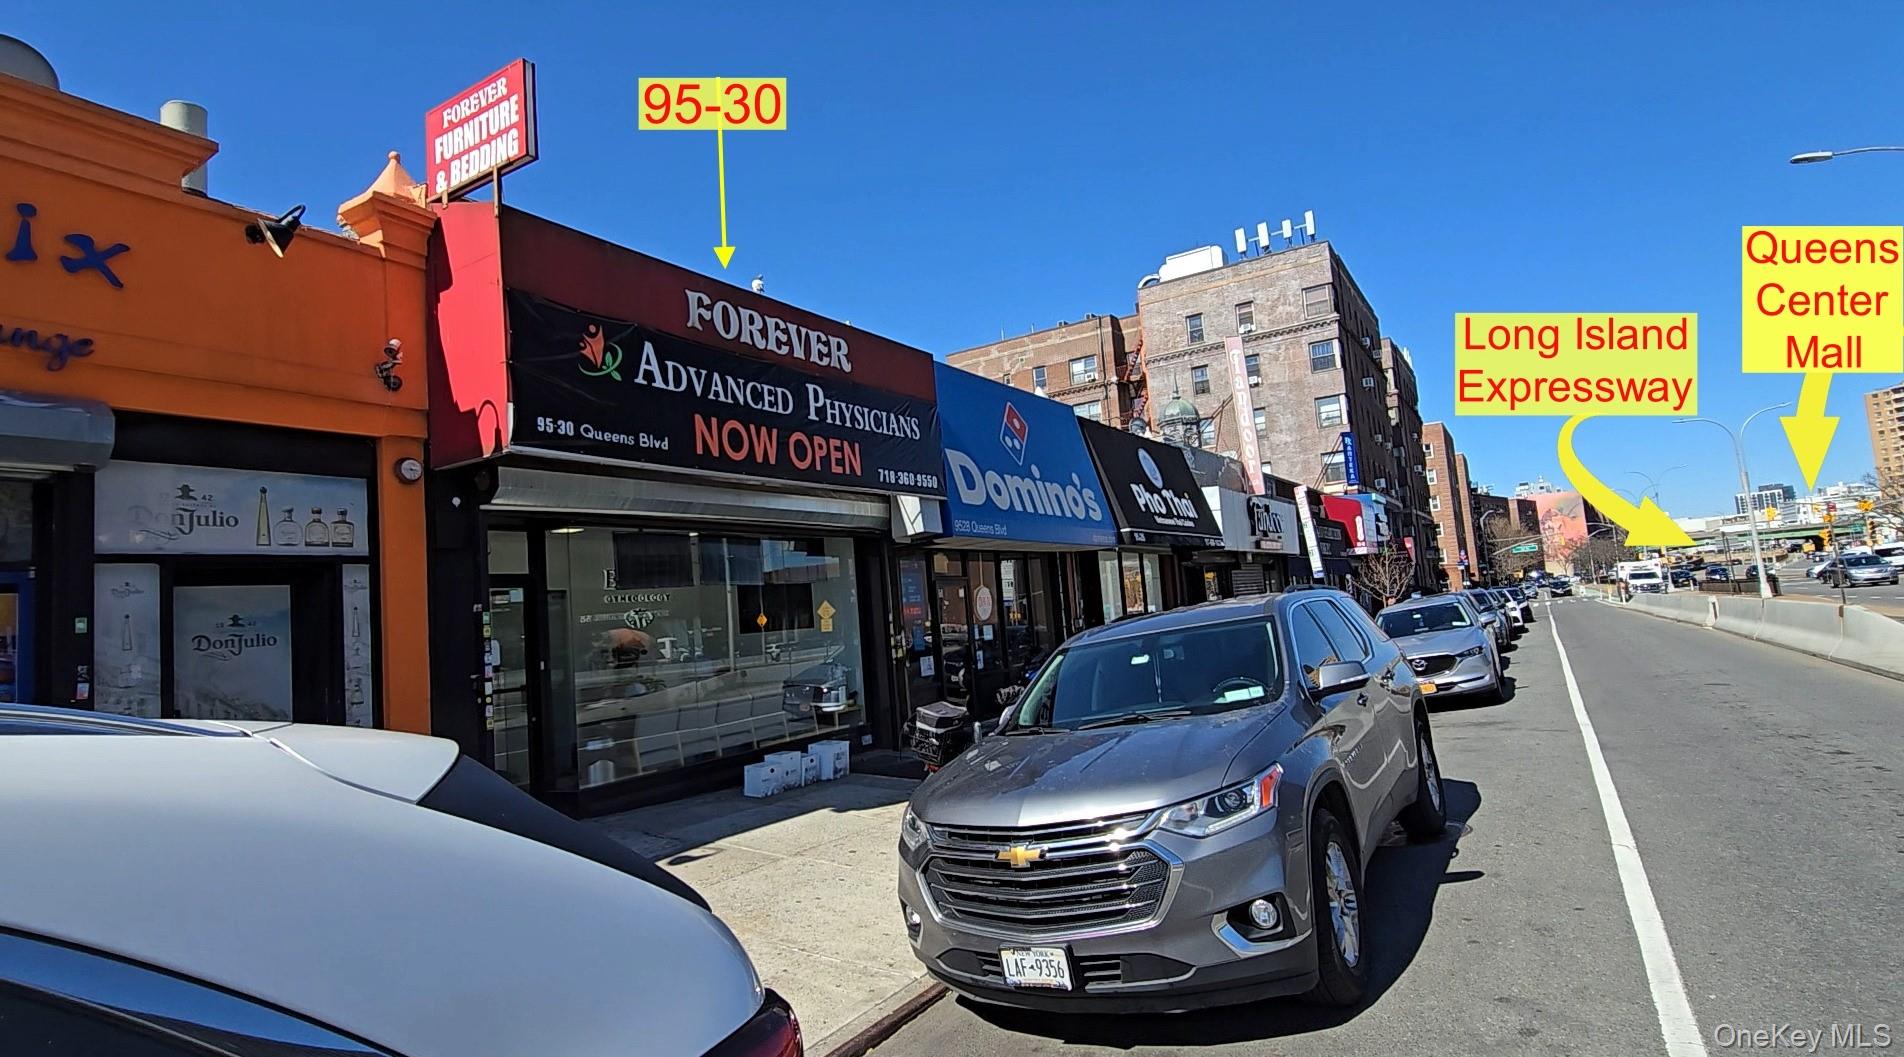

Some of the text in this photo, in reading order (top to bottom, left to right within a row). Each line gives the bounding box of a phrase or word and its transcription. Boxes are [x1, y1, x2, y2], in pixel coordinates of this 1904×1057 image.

[434, 93, 520, 165] FURNITURE
[442, 77, 508, 129] FOREVER
[436, 127, 519, 194] & BEDDING
[685, 288, 852, 373] FOREVER
[634, 341, 921, 440] ADVANCED PHYSICIANS
[537, 416, 669, 451] 95-30 Queens Blvd
[694, 413, 862, 477] NOW OPEN
[877, 467, 938, 489] 718-360-9550
[944, 447, 1103, 522] Domino's
[1130, 483, 1199, 519] Pho Thai
[176, 507, 240, 536] Julio
[192, 633, 277, 656] Don Julio
[1033, 950, 1049, 958] YORK
